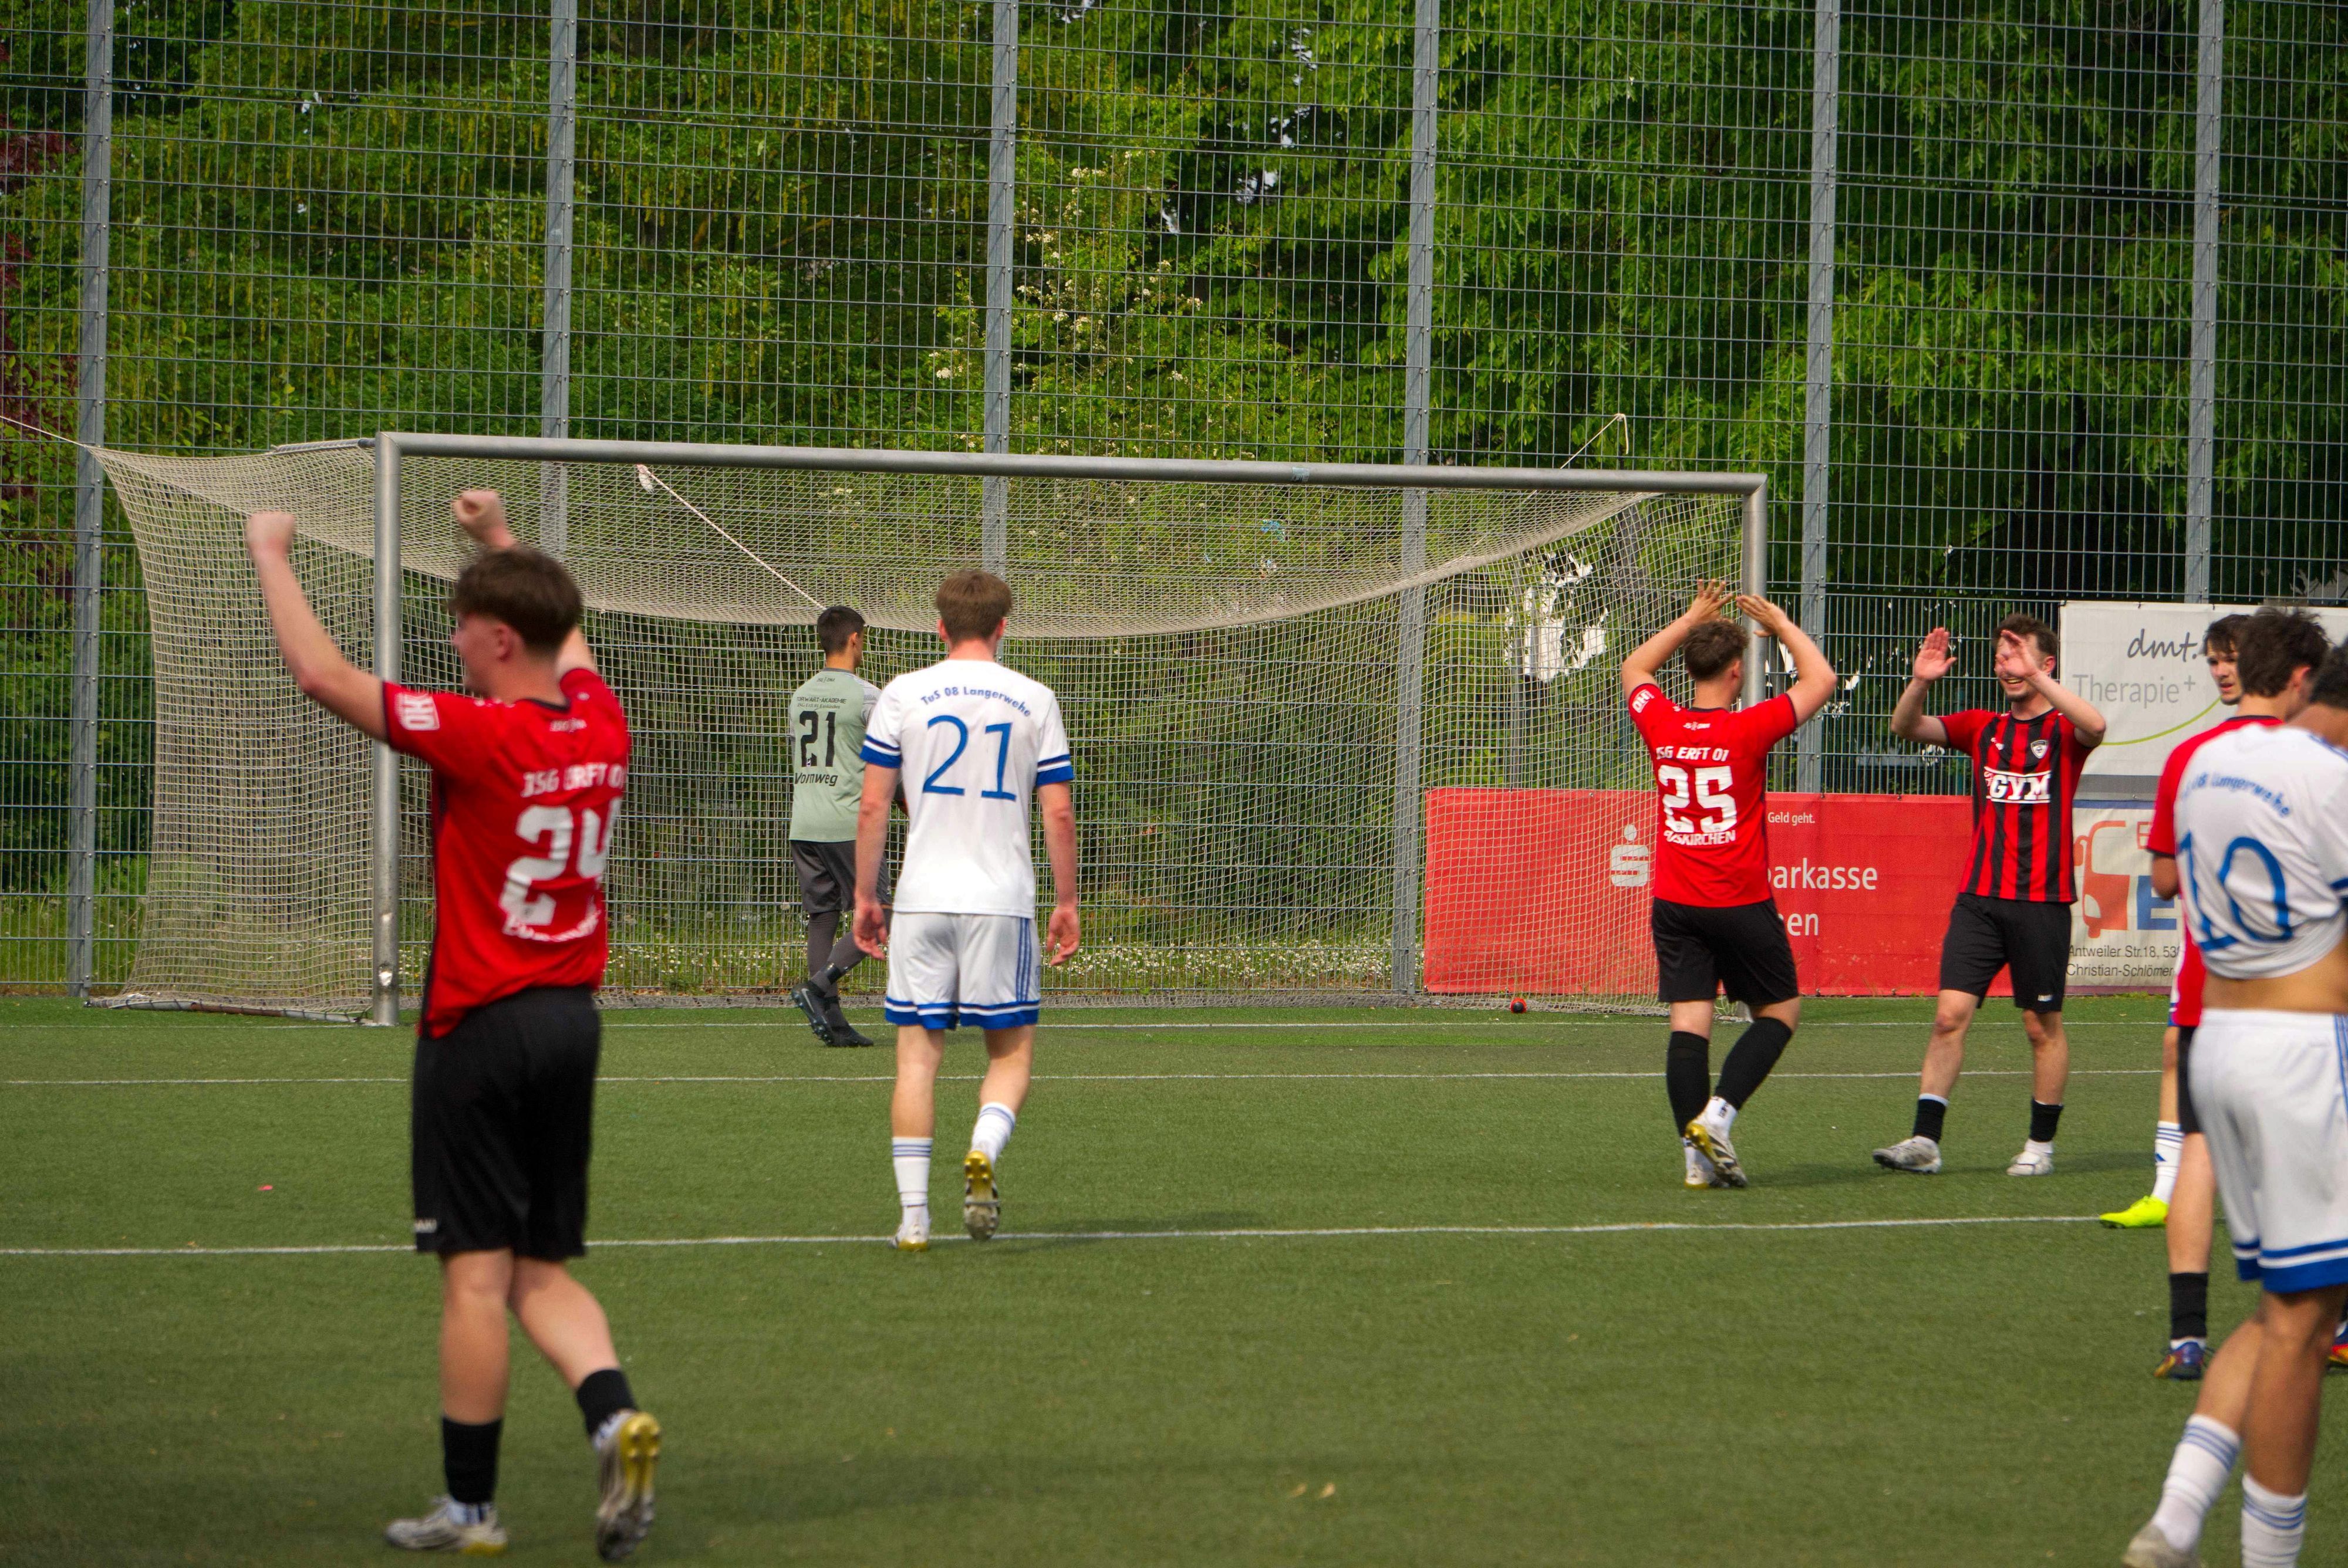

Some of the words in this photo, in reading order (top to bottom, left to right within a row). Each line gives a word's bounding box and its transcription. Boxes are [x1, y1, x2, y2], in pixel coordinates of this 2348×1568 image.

[2127, 628, 2198, 663] dmt.
[920, 690, 941, 705] TuS
[944, 686, 959, 697] 08
[963, 687, 1031, 717] Langerwehe
[799, 711, 836, 767] 21
[1676, 746, 1711, 761] ERFT
[1712, 748, 1729, 762] 01
[923, 715, 1016, 802] 21
[794, 772, 838, 786] Vornweg
[1989, 773, 2051, 800] GYM
[1658, 764, 1738, 834] 25
[1767, 812, 1789, 823] Geld
[1792, 813, 1816, 826] geht.
[1664, 830, 1736, 846] SKIRCHEN
[1767, 857, 1878, 890] arkasse
[2176, 831, 2293, 952] 10
[2069, 945, 2121, 958] Antweiler
